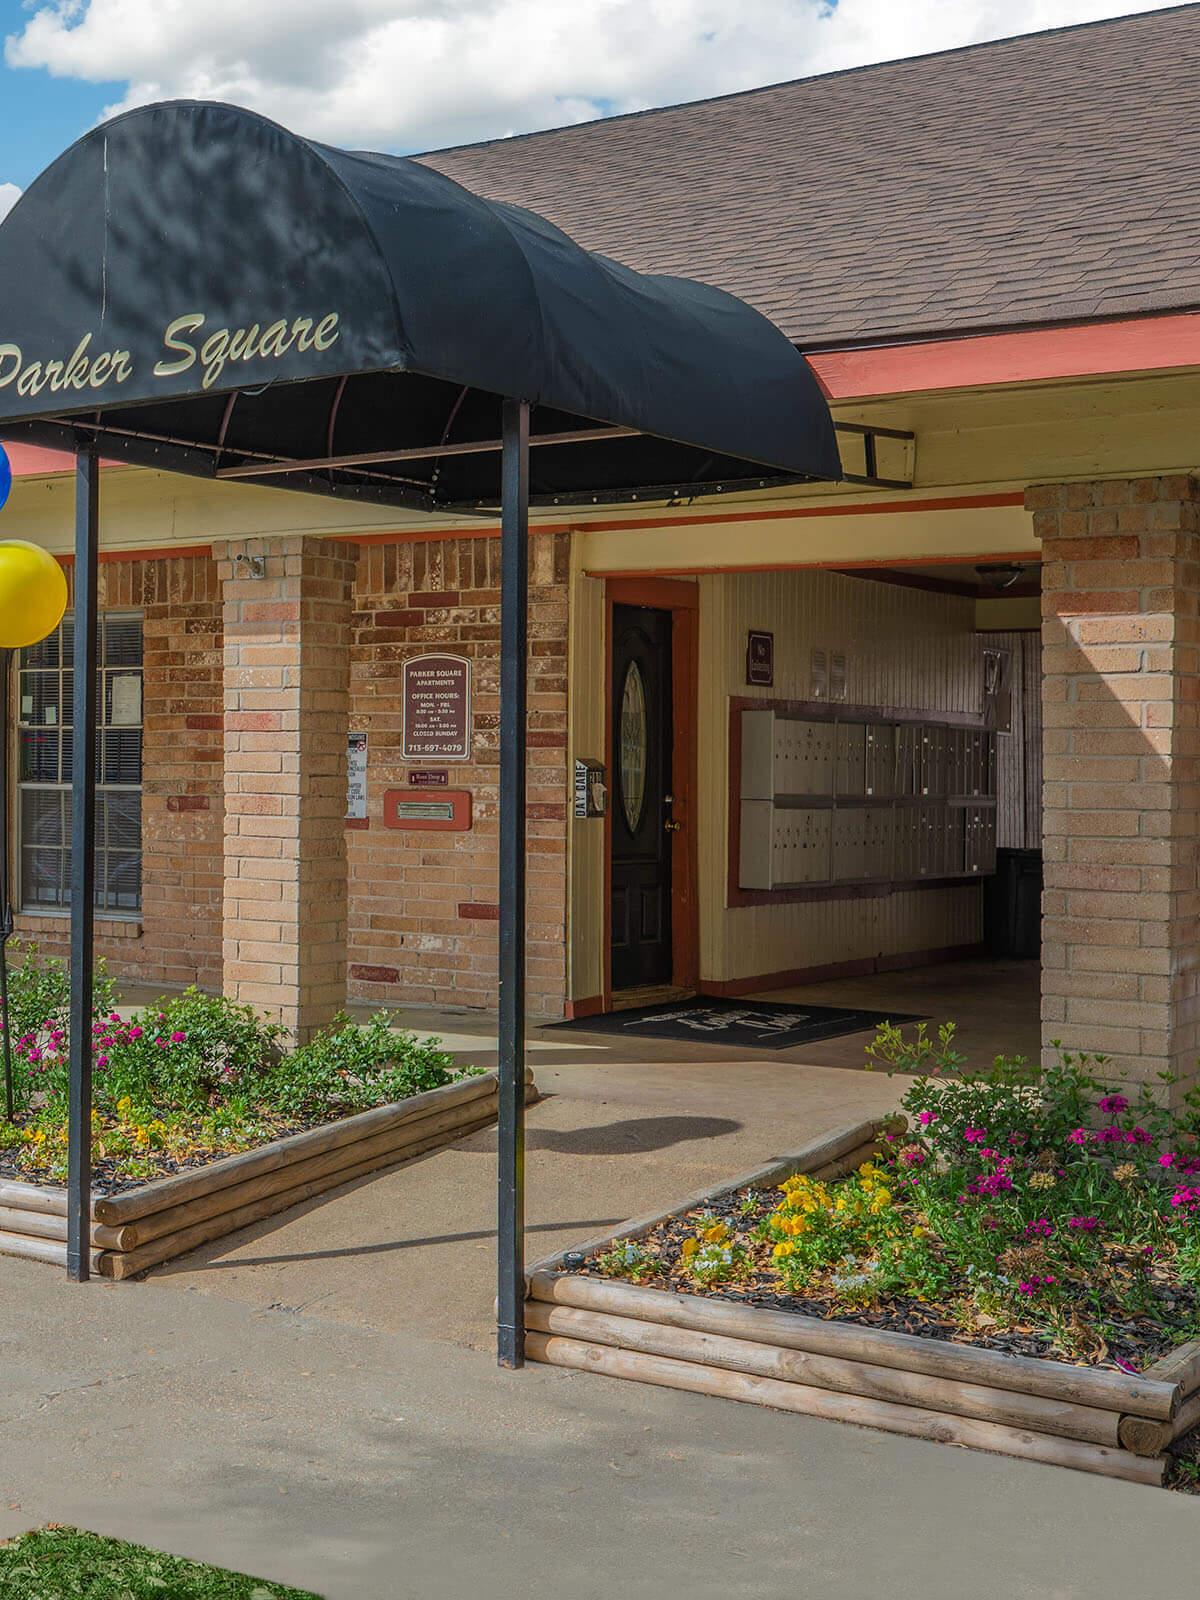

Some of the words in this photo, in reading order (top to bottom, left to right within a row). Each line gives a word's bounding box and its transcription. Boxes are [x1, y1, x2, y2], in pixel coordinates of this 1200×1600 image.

[153, 312, 340, 391] Square
[436, 669, 462, 677] SQUARE
[408, 744, 462, 752] 713-697-4079
[575, 765, 586, 791] CARE
[575, 796, 586, 817] DAY
